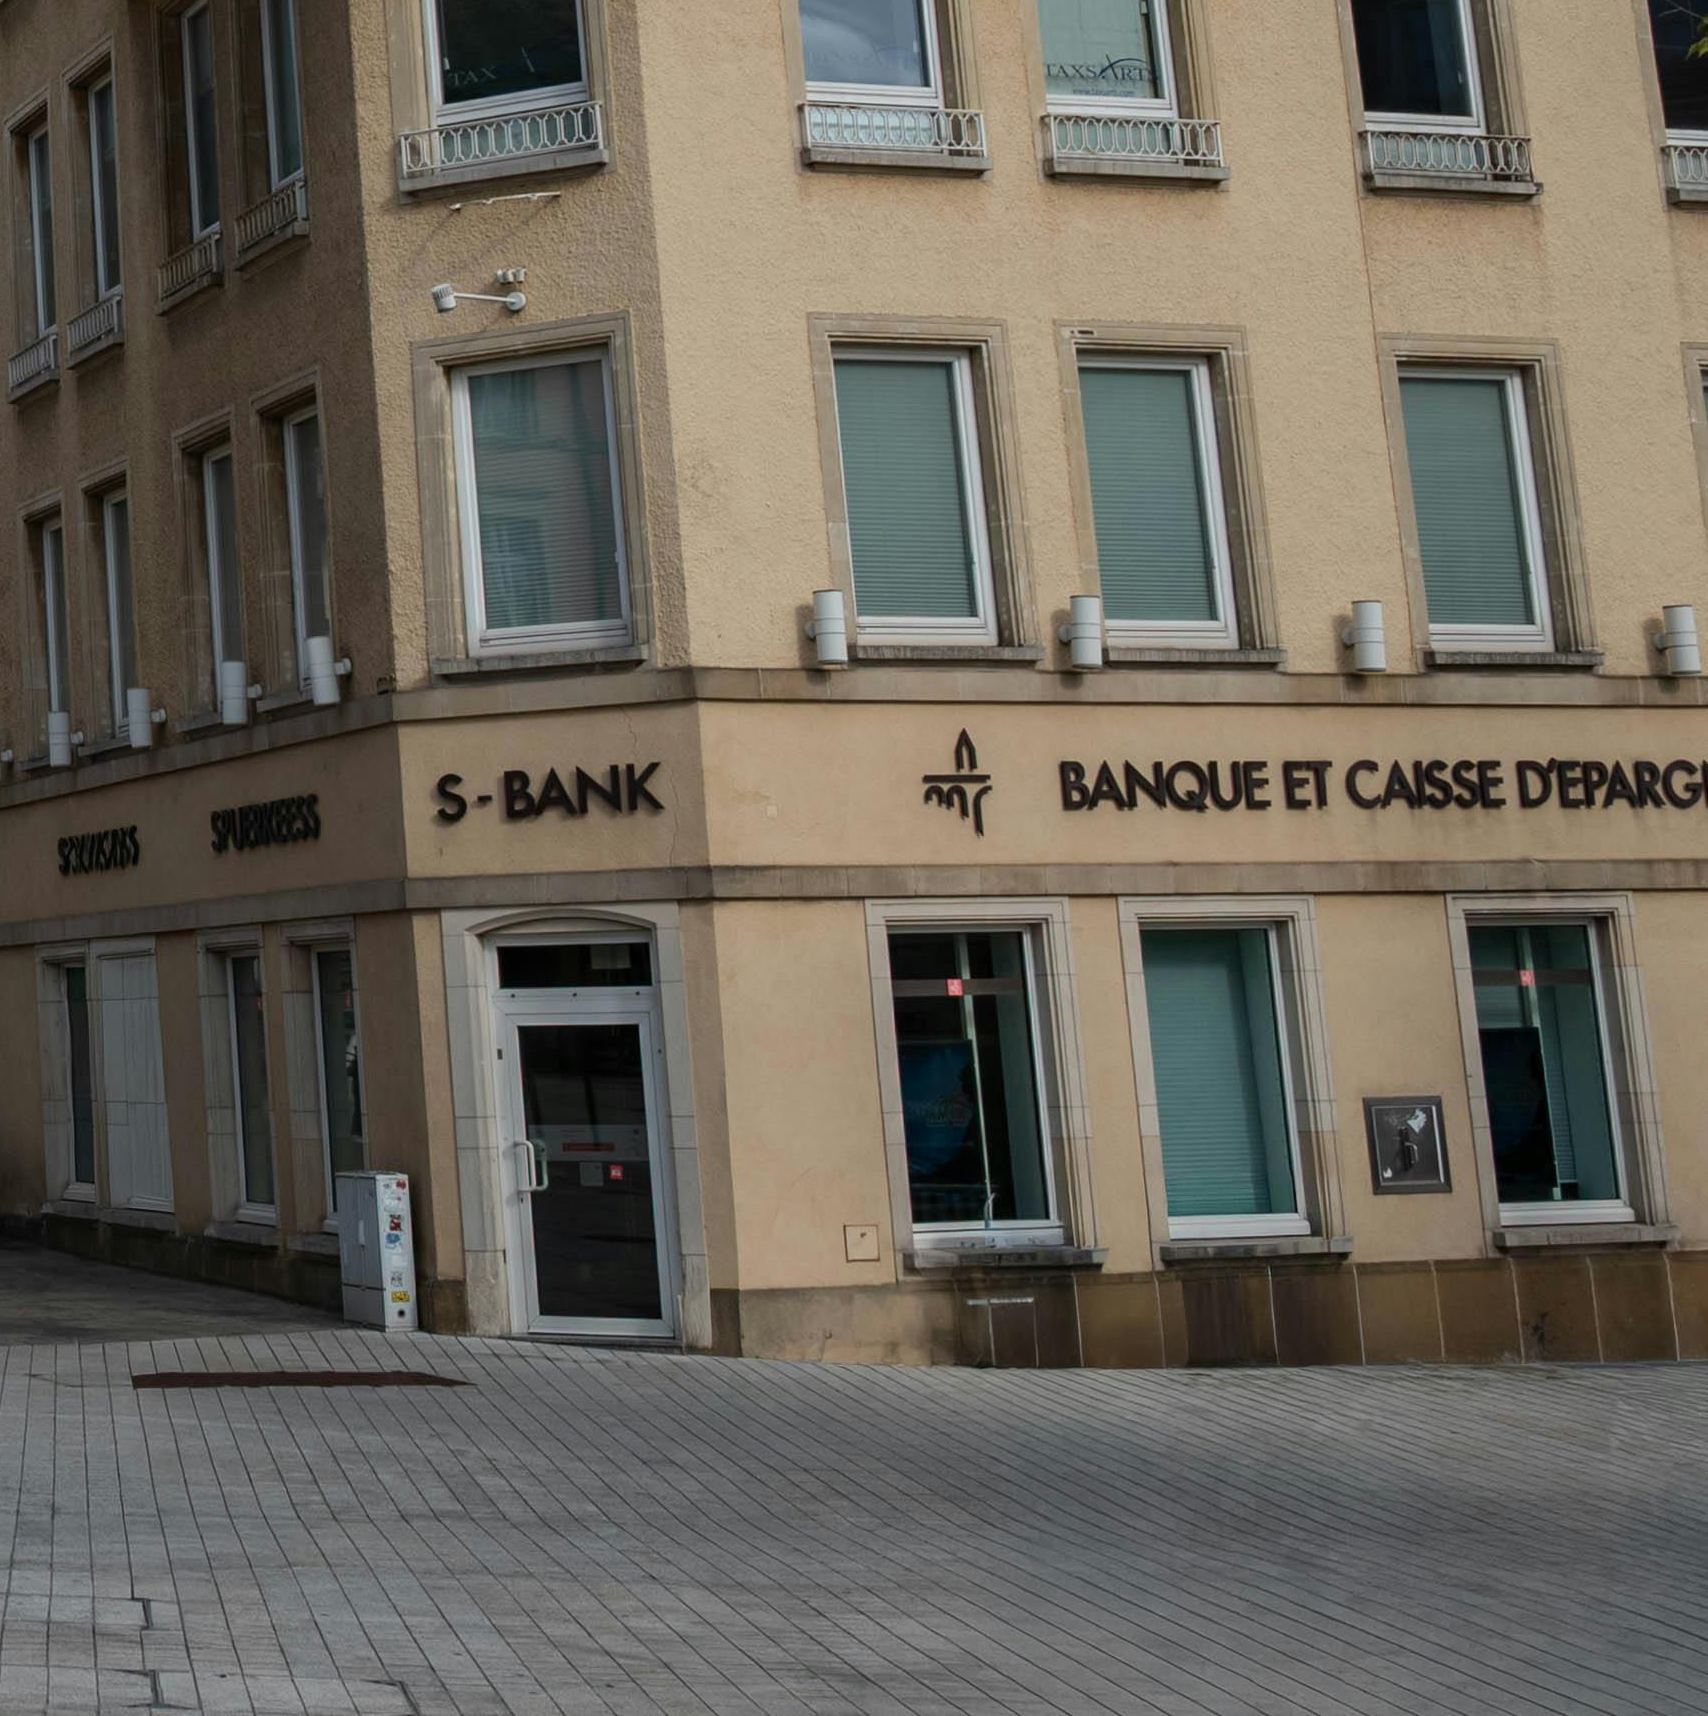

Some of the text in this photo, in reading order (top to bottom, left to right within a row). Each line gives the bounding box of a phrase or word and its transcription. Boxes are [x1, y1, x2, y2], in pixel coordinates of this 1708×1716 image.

[1059, 757, 1708, 812] BANQUE ET CAISSE D'EPARG
